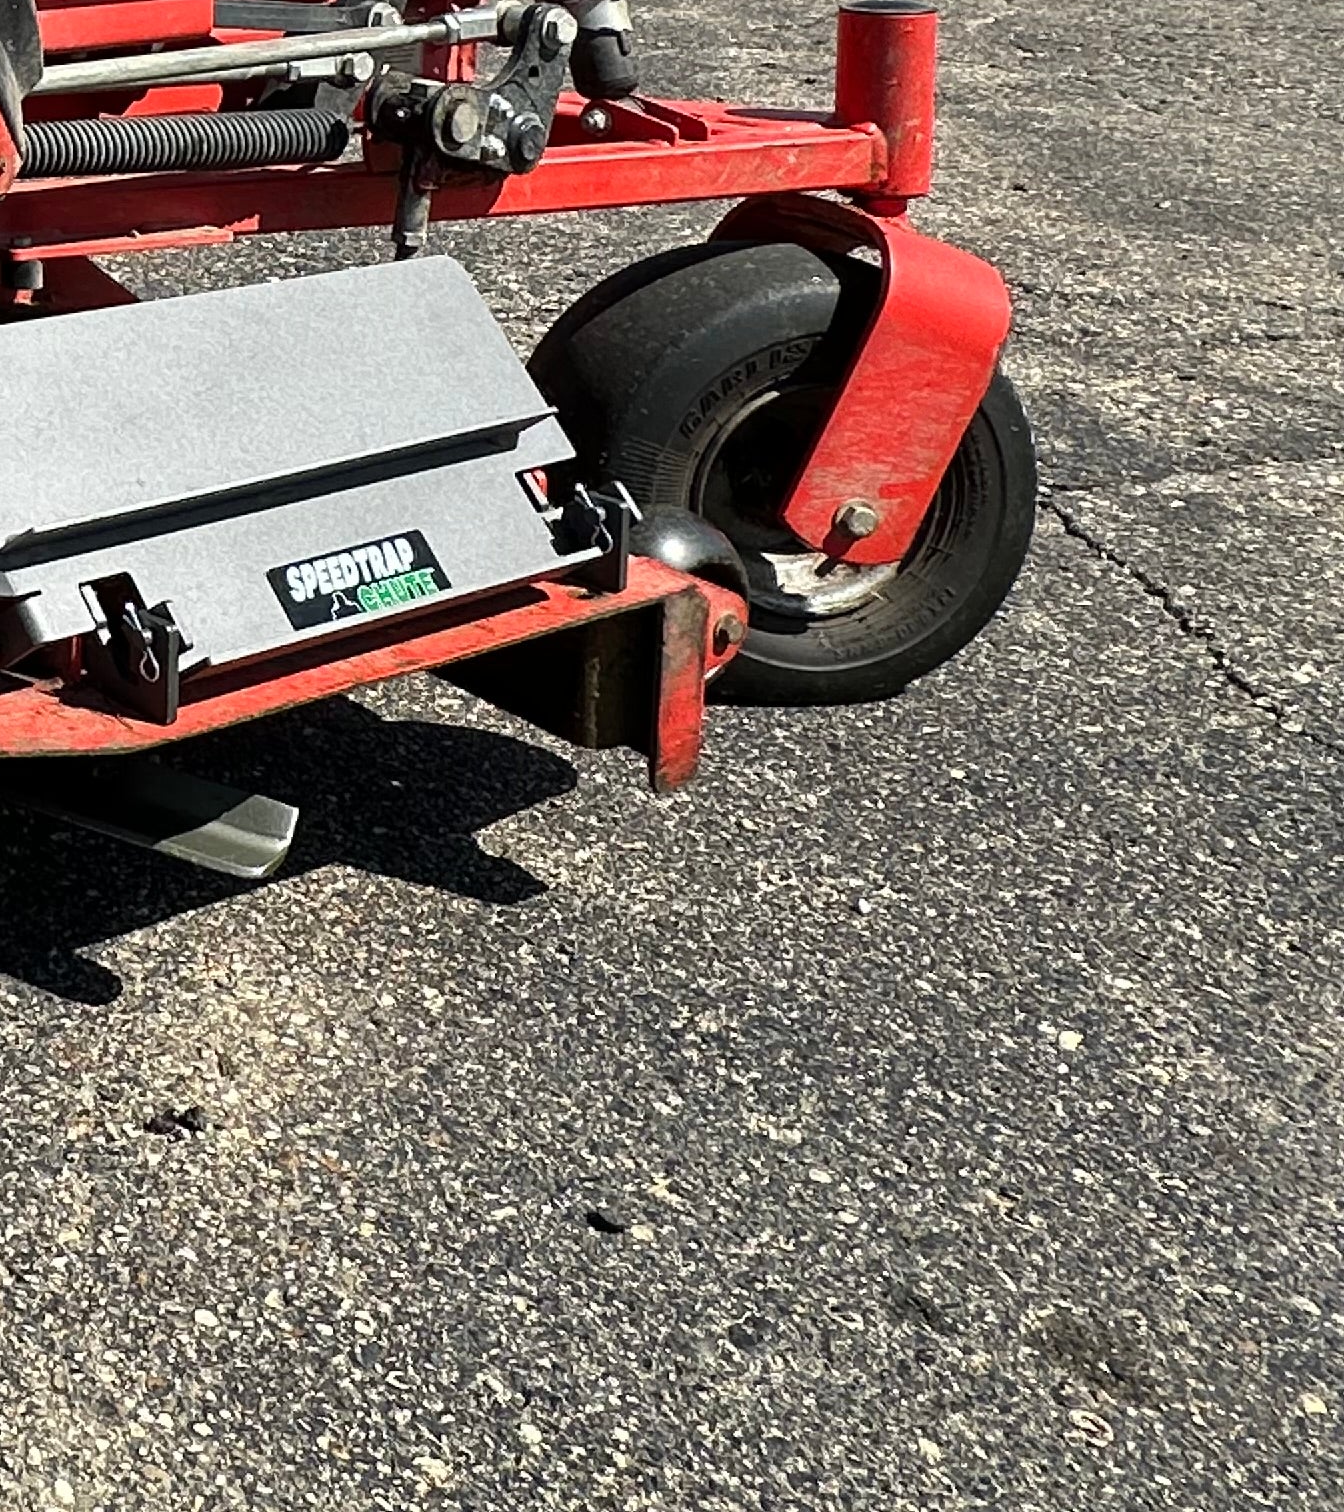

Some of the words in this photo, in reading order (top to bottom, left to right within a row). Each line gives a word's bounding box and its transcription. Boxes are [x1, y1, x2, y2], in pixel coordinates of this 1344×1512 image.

[678, 342, 811, 440] CARLIS
[286, 537, 415, 603] SPEEDTRAP
[357, 566, 436, 613] CHUTE
